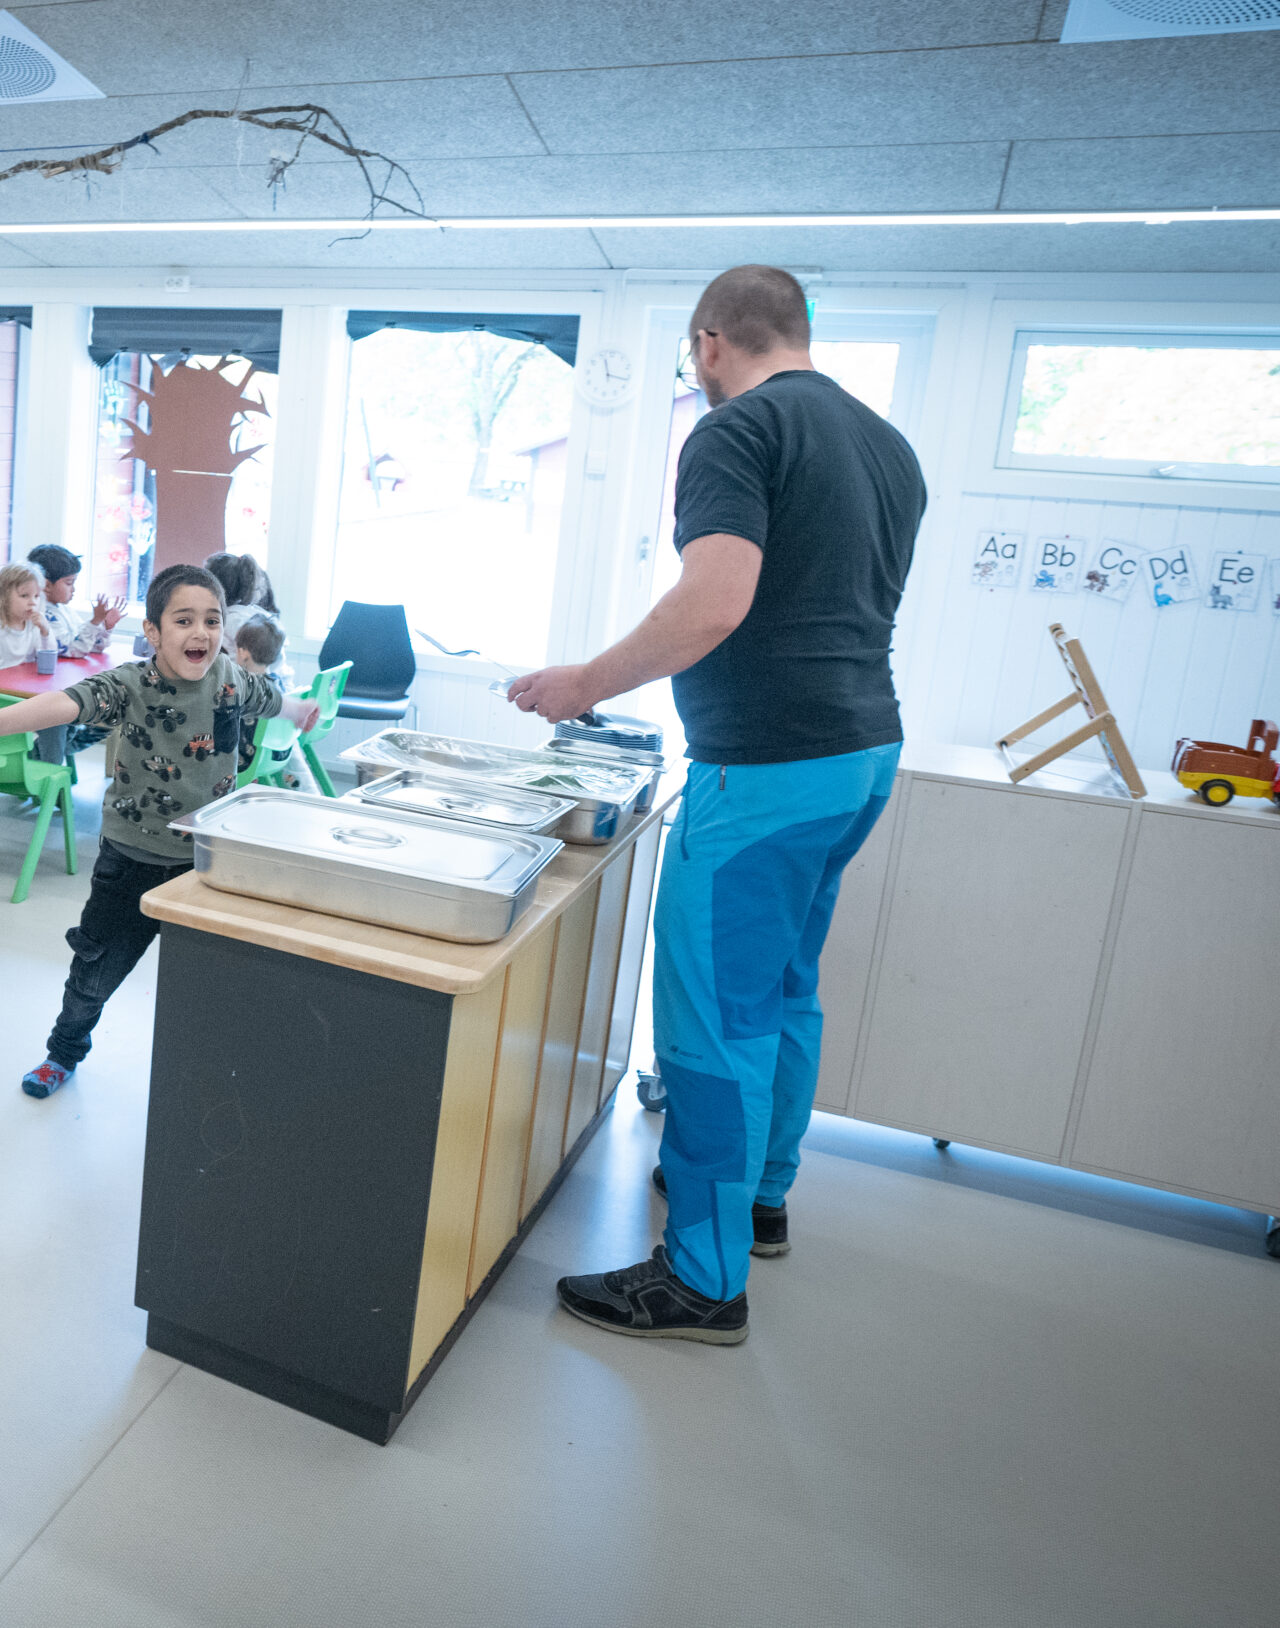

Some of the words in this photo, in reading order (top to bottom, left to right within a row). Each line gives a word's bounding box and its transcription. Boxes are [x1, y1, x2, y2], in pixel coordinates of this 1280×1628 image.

[980, 536, 1018, 559] Aa
[1041, 543, 1076, 567] Bb
[1099, 547, 1137, 576] Cc
[1148, 549, 1189, 581] Dd
[1217, 558, 1255, 584] Ee
